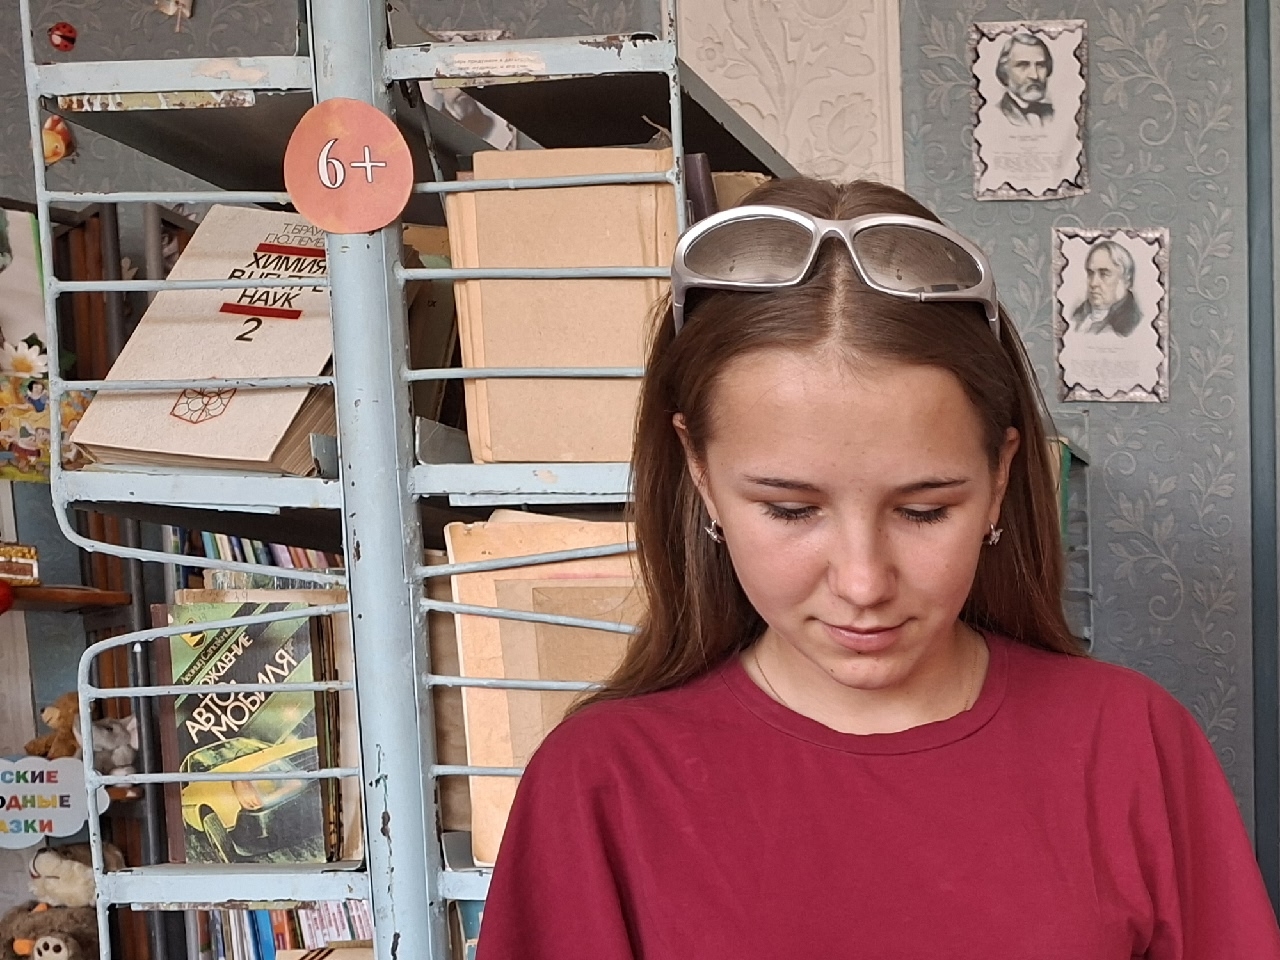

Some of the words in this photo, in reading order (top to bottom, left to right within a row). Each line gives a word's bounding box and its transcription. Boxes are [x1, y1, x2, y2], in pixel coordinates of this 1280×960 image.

[317, 138, 387, 190] 6+
[245, 252, 327, 275] ХИМИЯ
[236, 287, 302, 308] НАУК
[233, 316, 263, 343] 2
